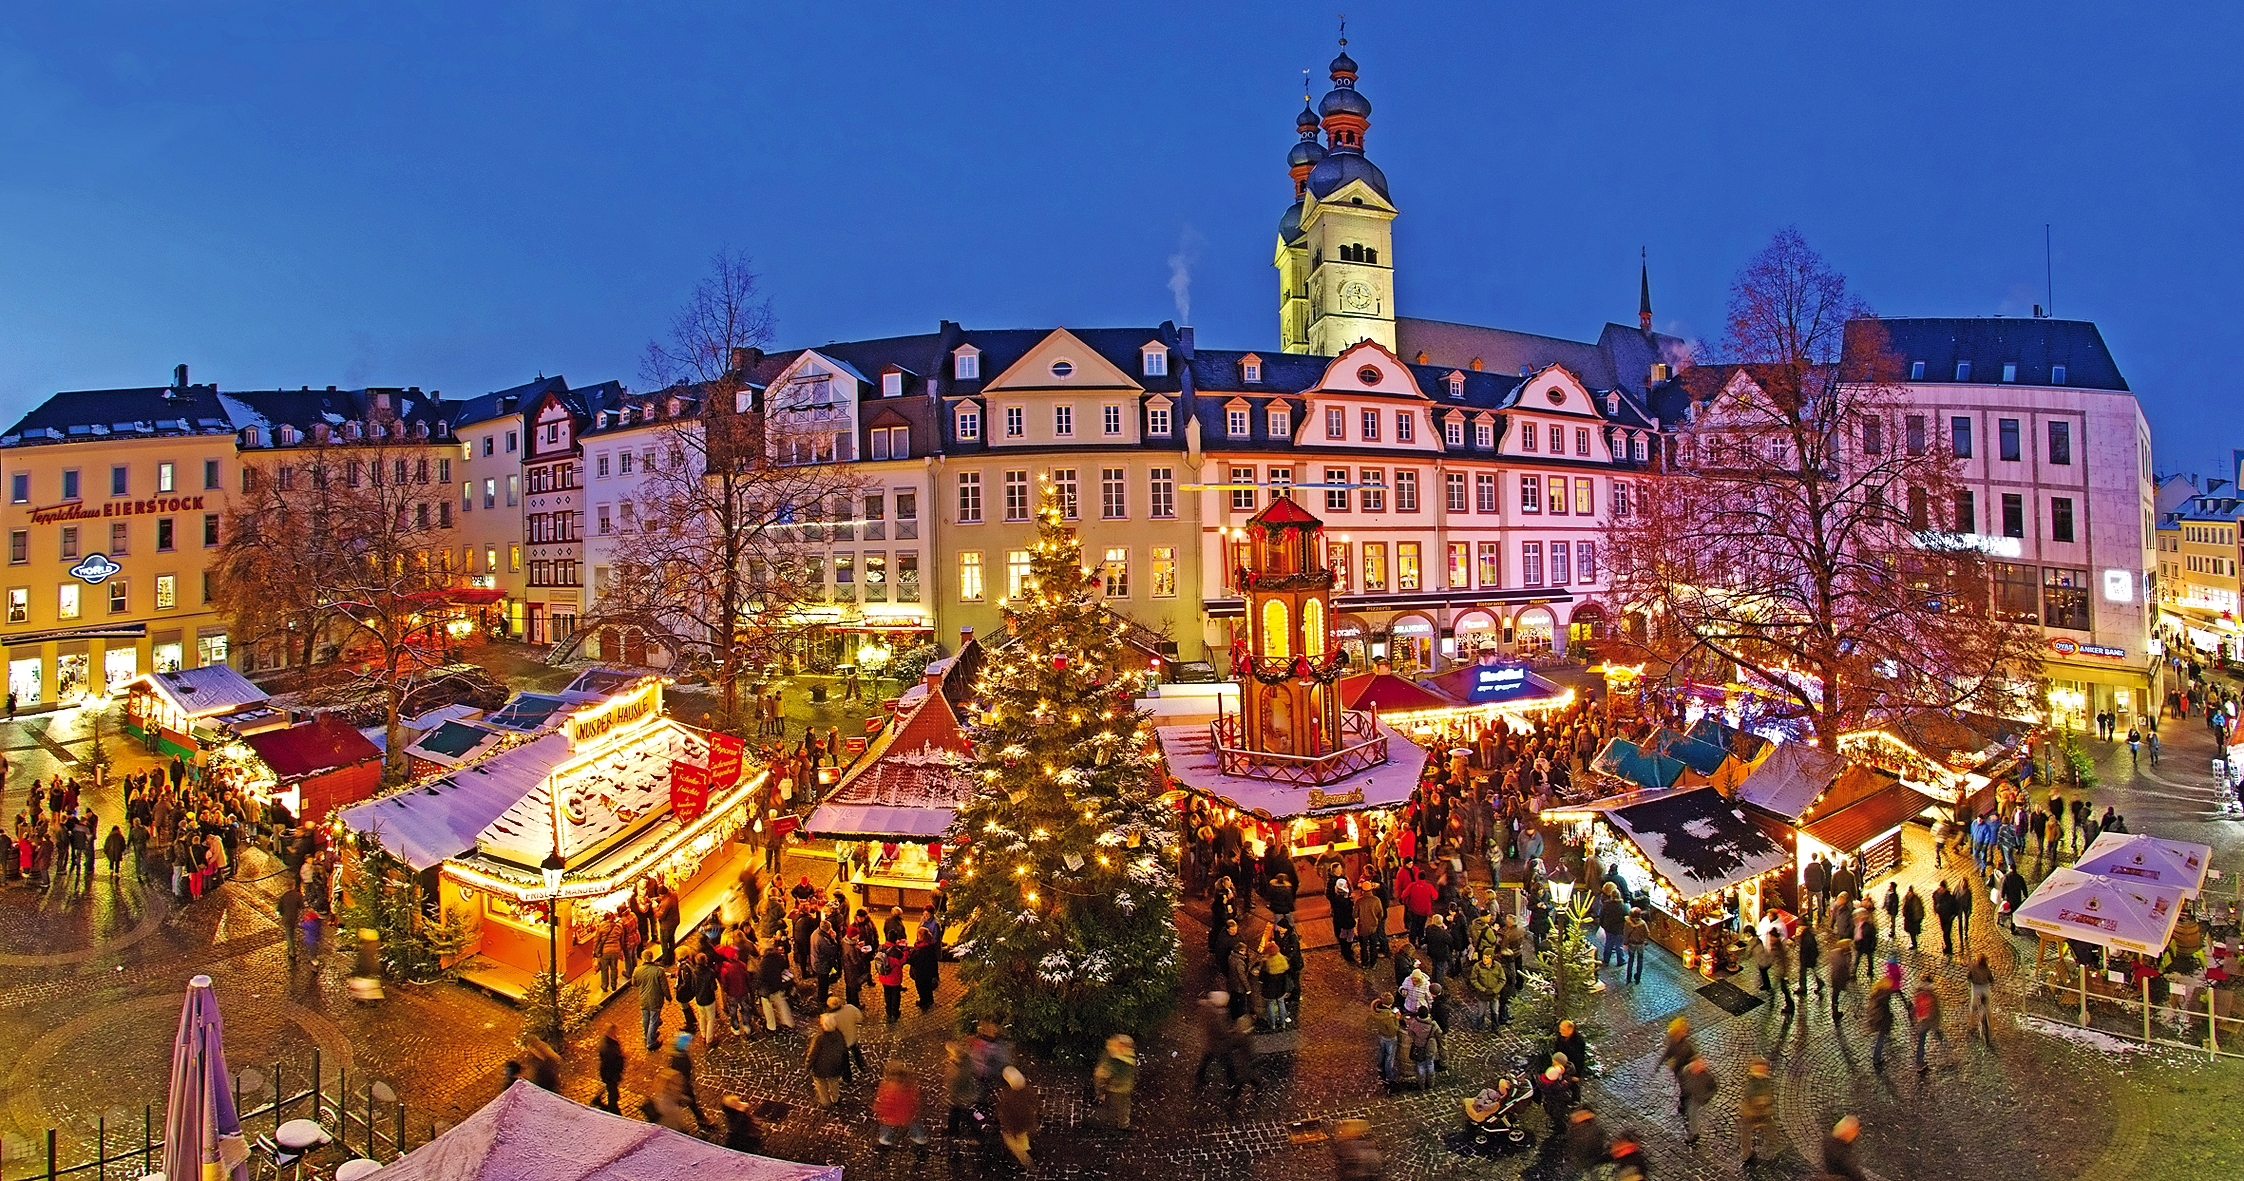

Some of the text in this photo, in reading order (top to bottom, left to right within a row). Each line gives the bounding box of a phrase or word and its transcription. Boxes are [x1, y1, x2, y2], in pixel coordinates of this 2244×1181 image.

[26, 496, 204, 525] Teppichhaus EIERSTOCK
[78, 565, 113, 576] WORLD
[2080, 644, 2103, 655] ANKER
[2104, 648, 2125, 657] BANK
[711, 743, 738, 756] Popcorn
[564, 885, 606, 896] MANDELN
